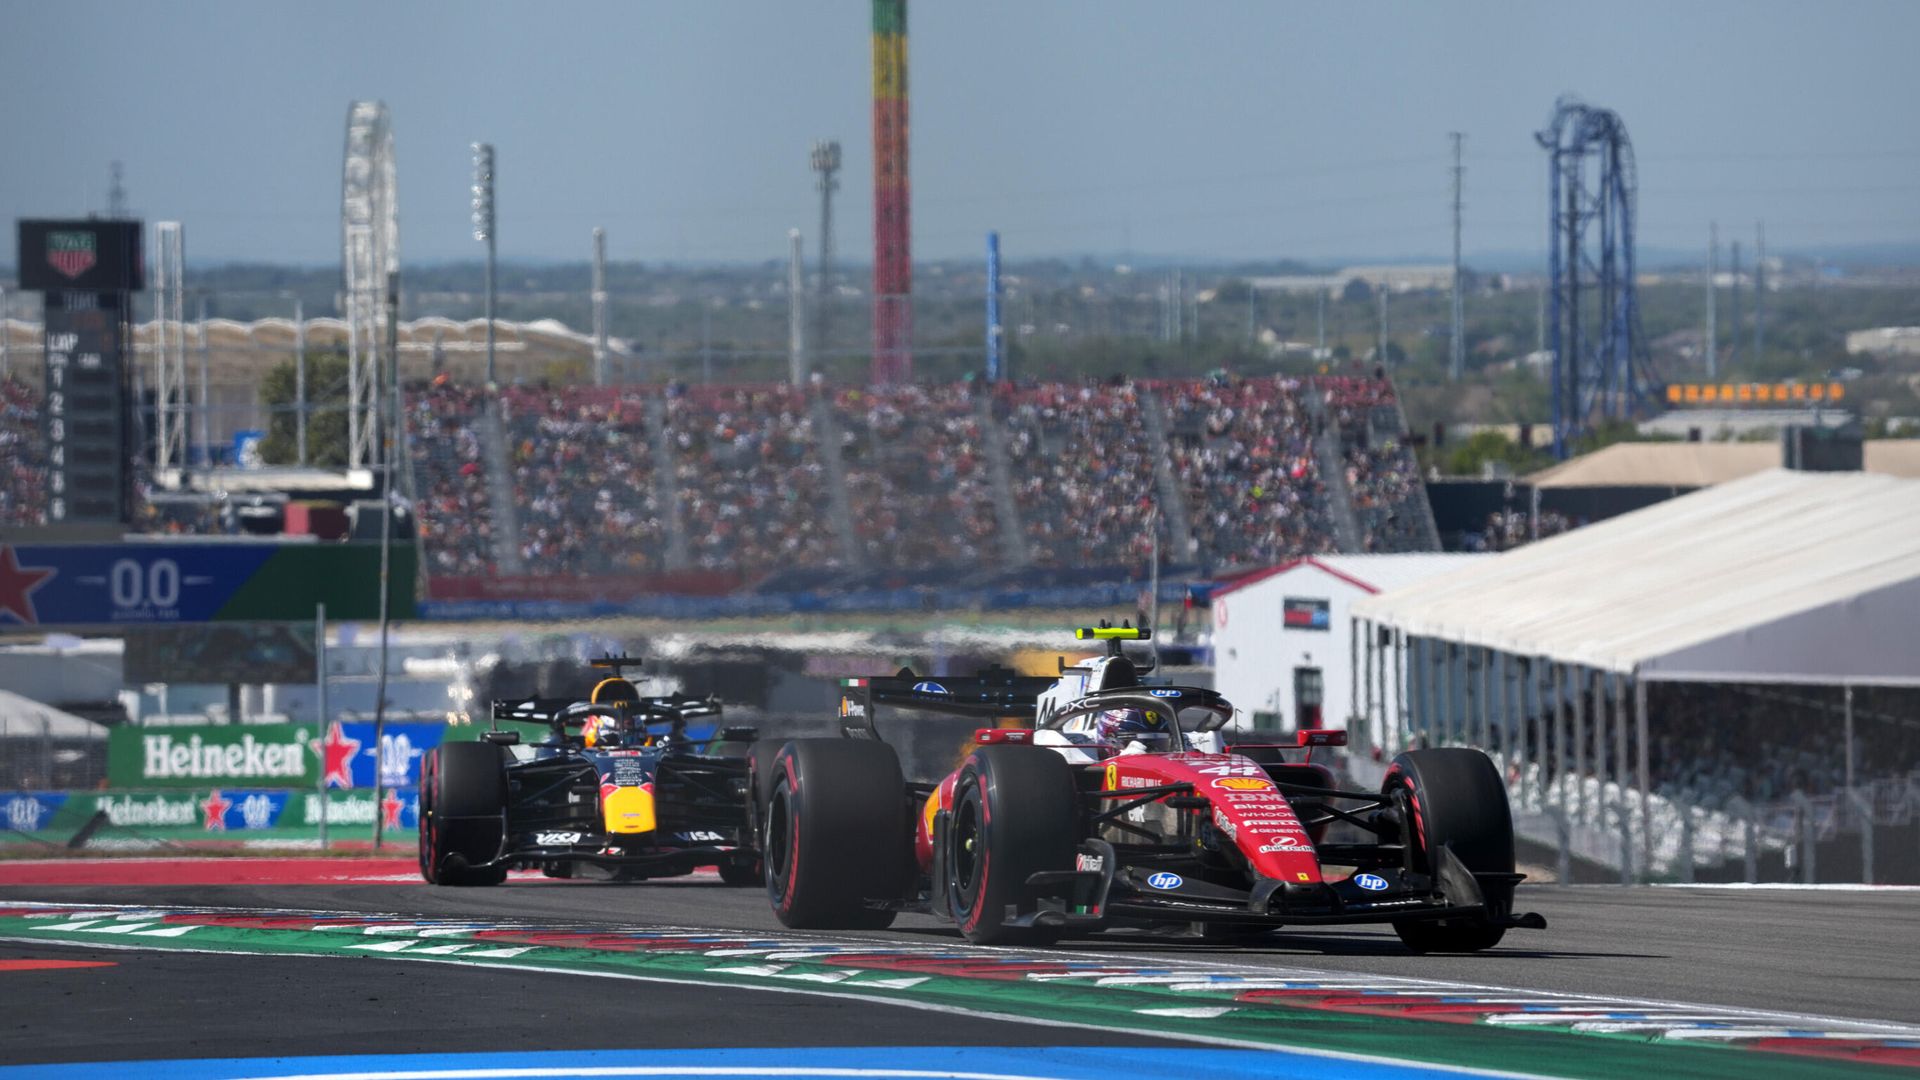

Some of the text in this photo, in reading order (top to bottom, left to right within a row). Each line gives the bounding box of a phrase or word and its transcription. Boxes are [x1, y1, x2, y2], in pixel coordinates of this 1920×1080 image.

[50, 392, 63, 415] 2
[144, 733, 305, 778] Heineken
[1198, 766, 1260, 776] 44
[1224, 793, 1286, 802] IBM
[536, 832, 582, 846] VISA
[674, 831, 725, 841] VISA
[1152, 872, 1178, 889] hp
